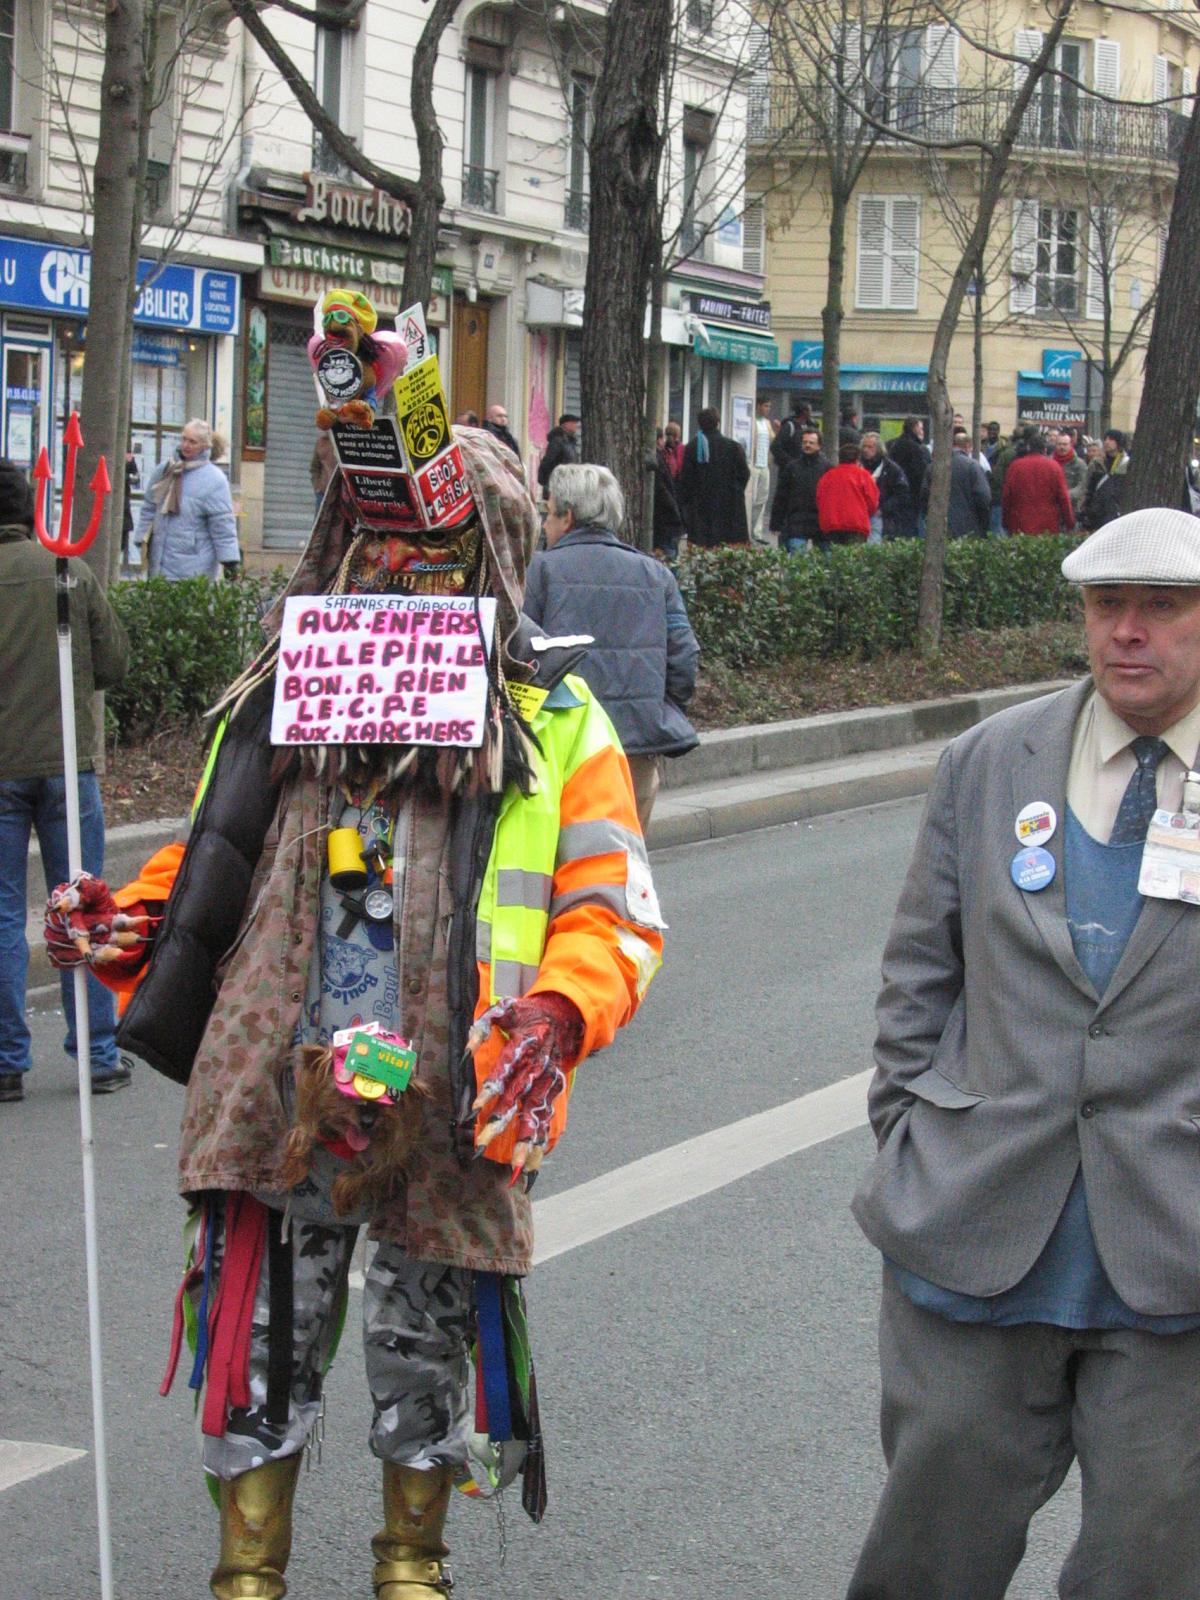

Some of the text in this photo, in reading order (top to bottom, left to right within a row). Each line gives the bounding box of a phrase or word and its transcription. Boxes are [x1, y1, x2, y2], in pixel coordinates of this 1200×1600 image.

[40, 250, 91, 308] CPH
[134, 284, 189, 322] OBILIER
[1065, 413, 1086, 423] SANT
[355, 475, 392, 487] Liberté
[325, 597, 383, 611] SATANAS
[377, 1050, 411, 1072] vital
